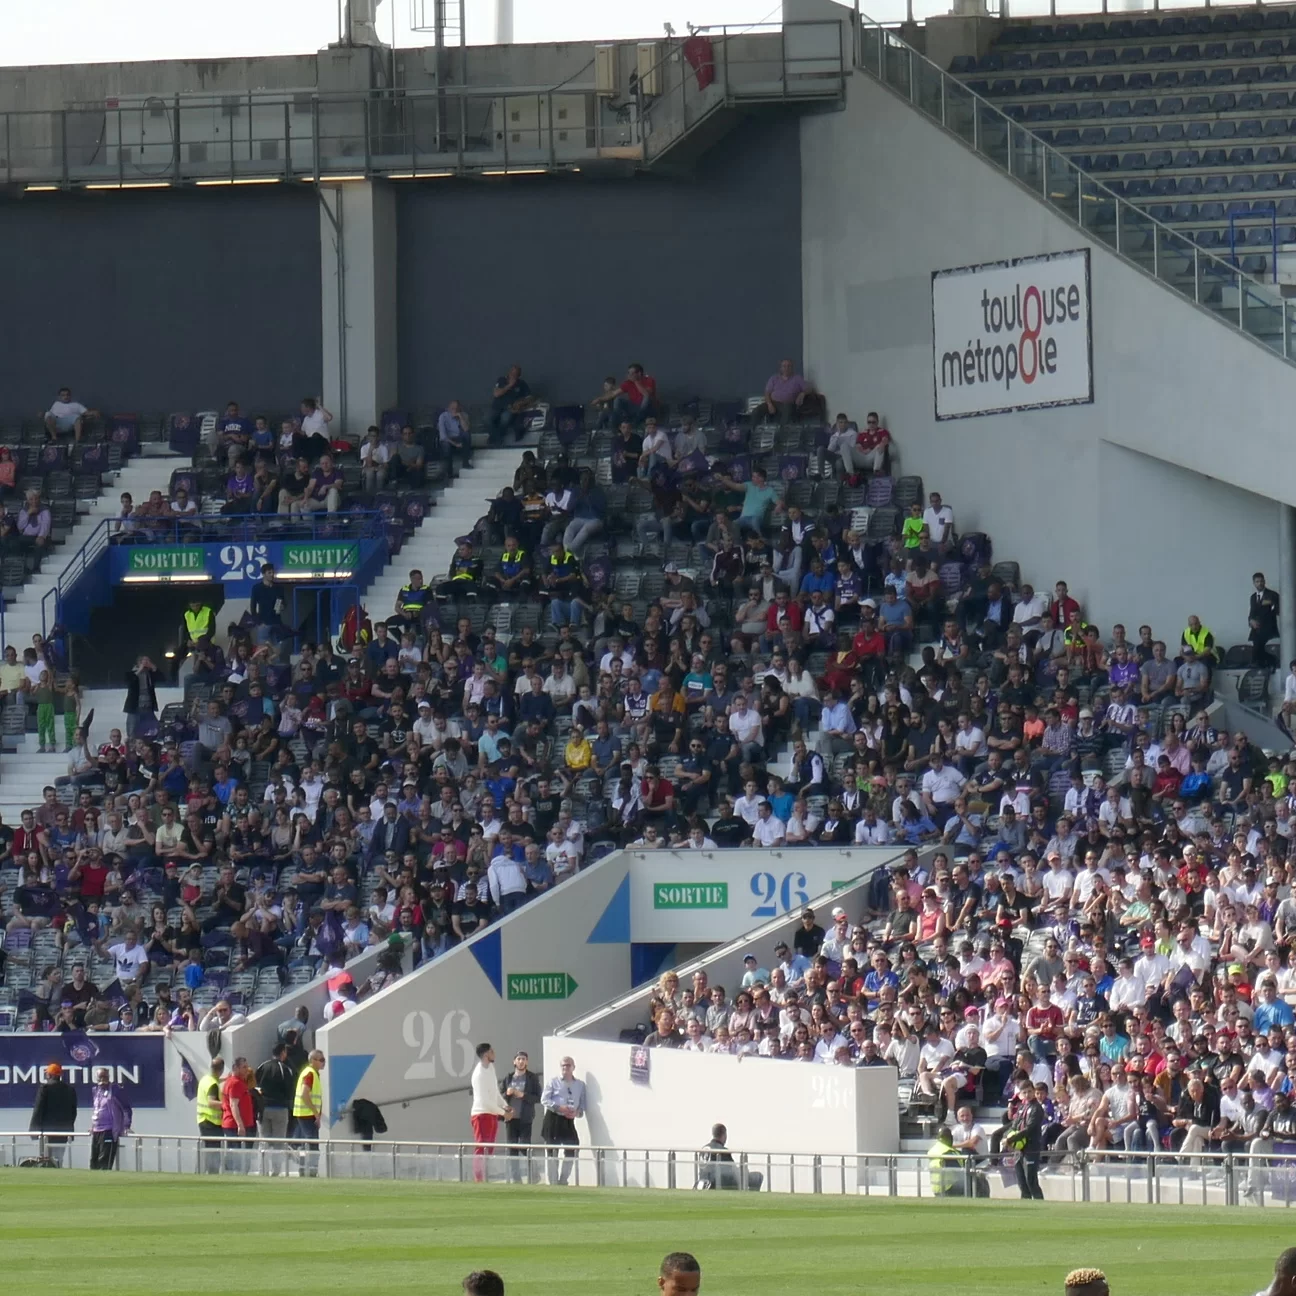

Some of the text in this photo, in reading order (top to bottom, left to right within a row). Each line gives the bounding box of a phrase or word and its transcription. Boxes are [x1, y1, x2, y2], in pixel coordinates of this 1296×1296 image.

[981, 284, 1080, 339] toulouse
[133, 545, 353, 581] SORTIE 25 SORTIE
[658, 871, 809, 917] SORTIE 26
[510, 977, 563, 996] SORTIE
[402, 1008, 475, 1080] 26
